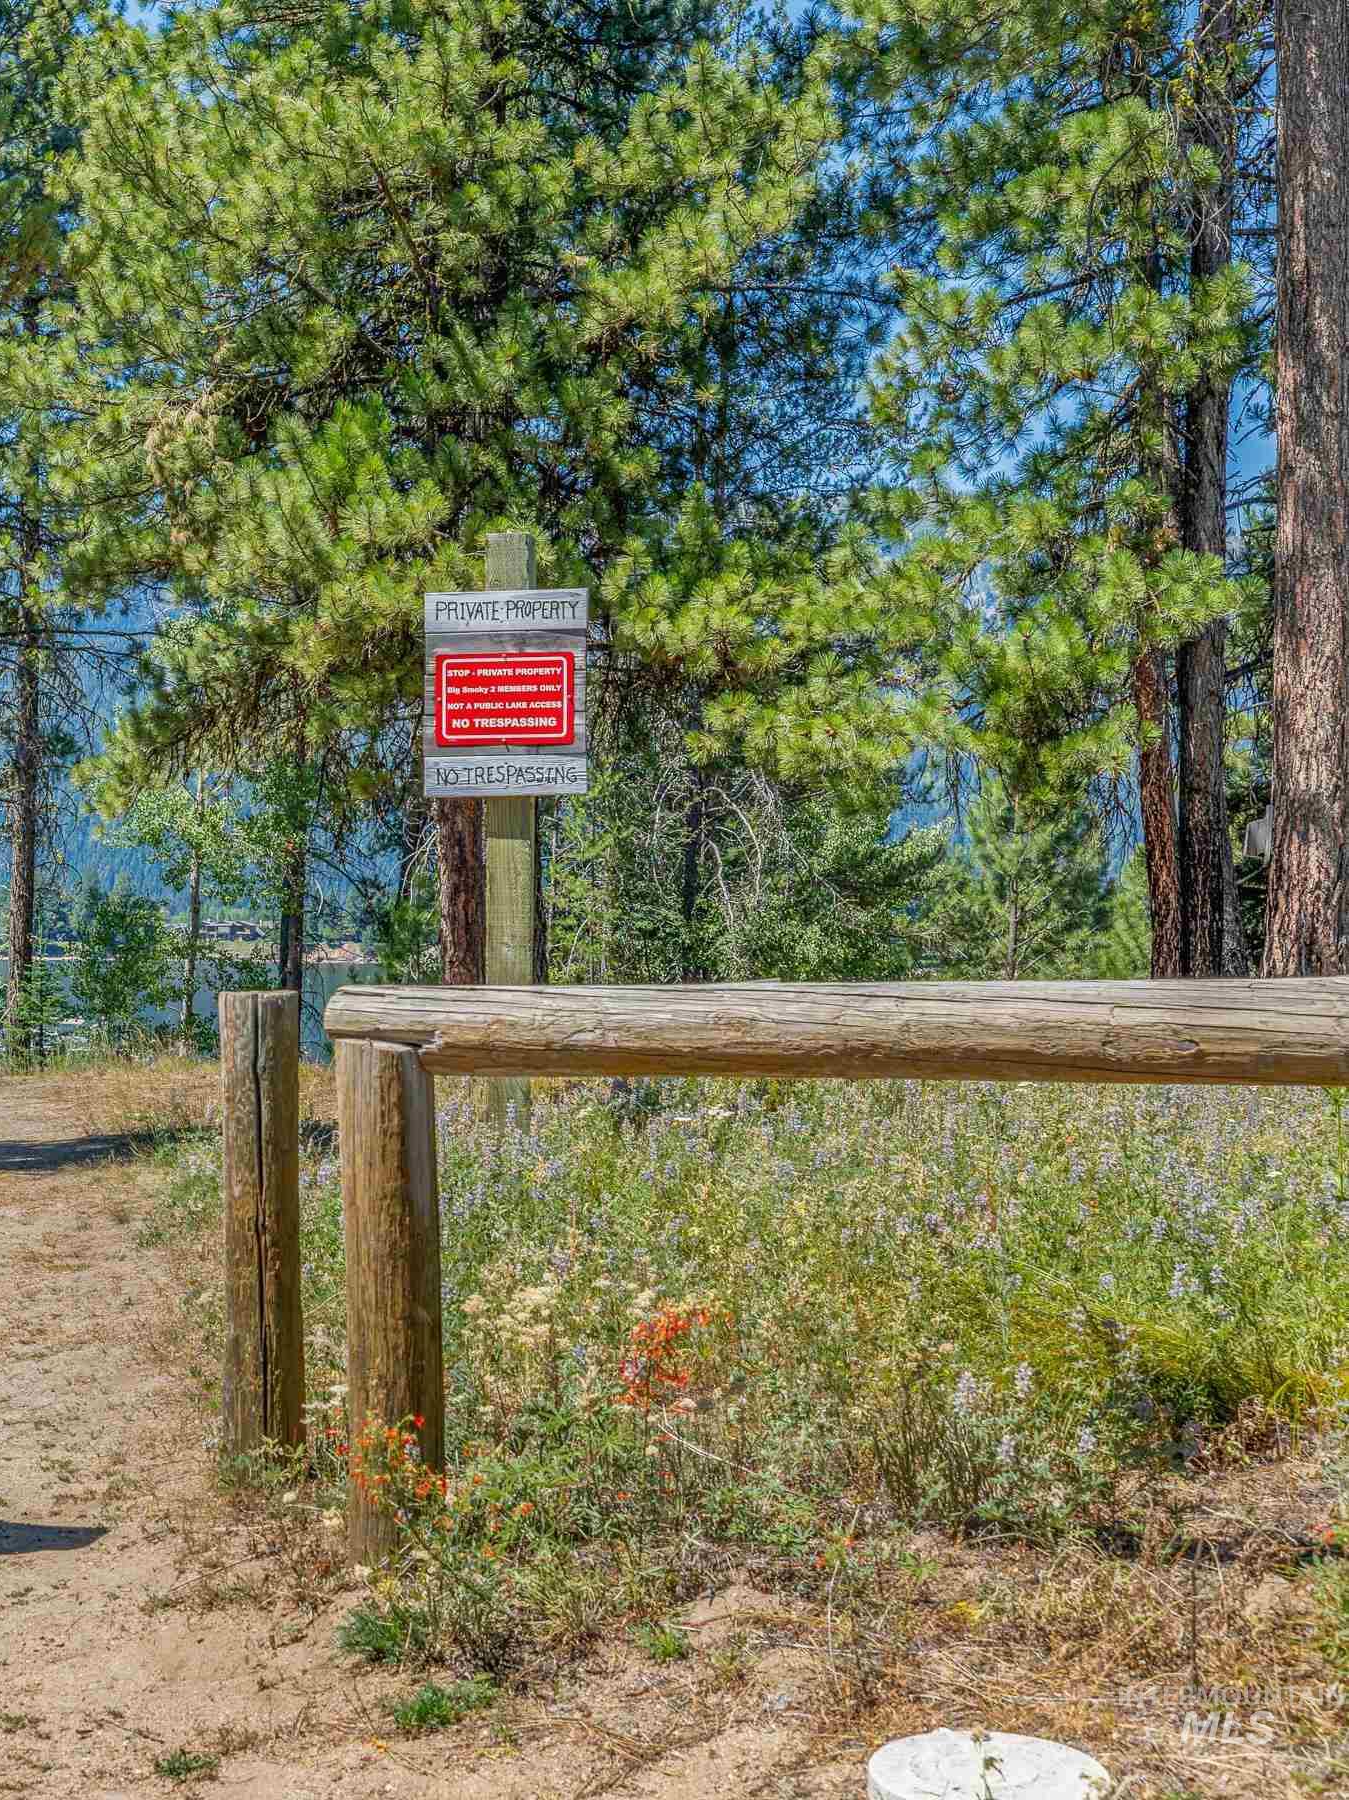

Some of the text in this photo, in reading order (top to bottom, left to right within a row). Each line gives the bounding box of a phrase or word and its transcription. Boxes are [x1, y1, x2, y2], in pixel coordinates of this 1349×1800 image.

[435, 600, 579, 621] PRIVATE PROPERTY
[447, 669, 470, 677] STOP
[477, 668, 514, 676] PRIVATE
[515, 667, 562, 676] PROPERTY
[462, 686, 489, 694] Smoky
[498, 685, 538, 693] MEMBERS
[540, 684, 562, 692] ONLY
[452, 717, 557, 728] NO TRESPASSING
[436, 765, 578, 785] NO TRESPASSING
